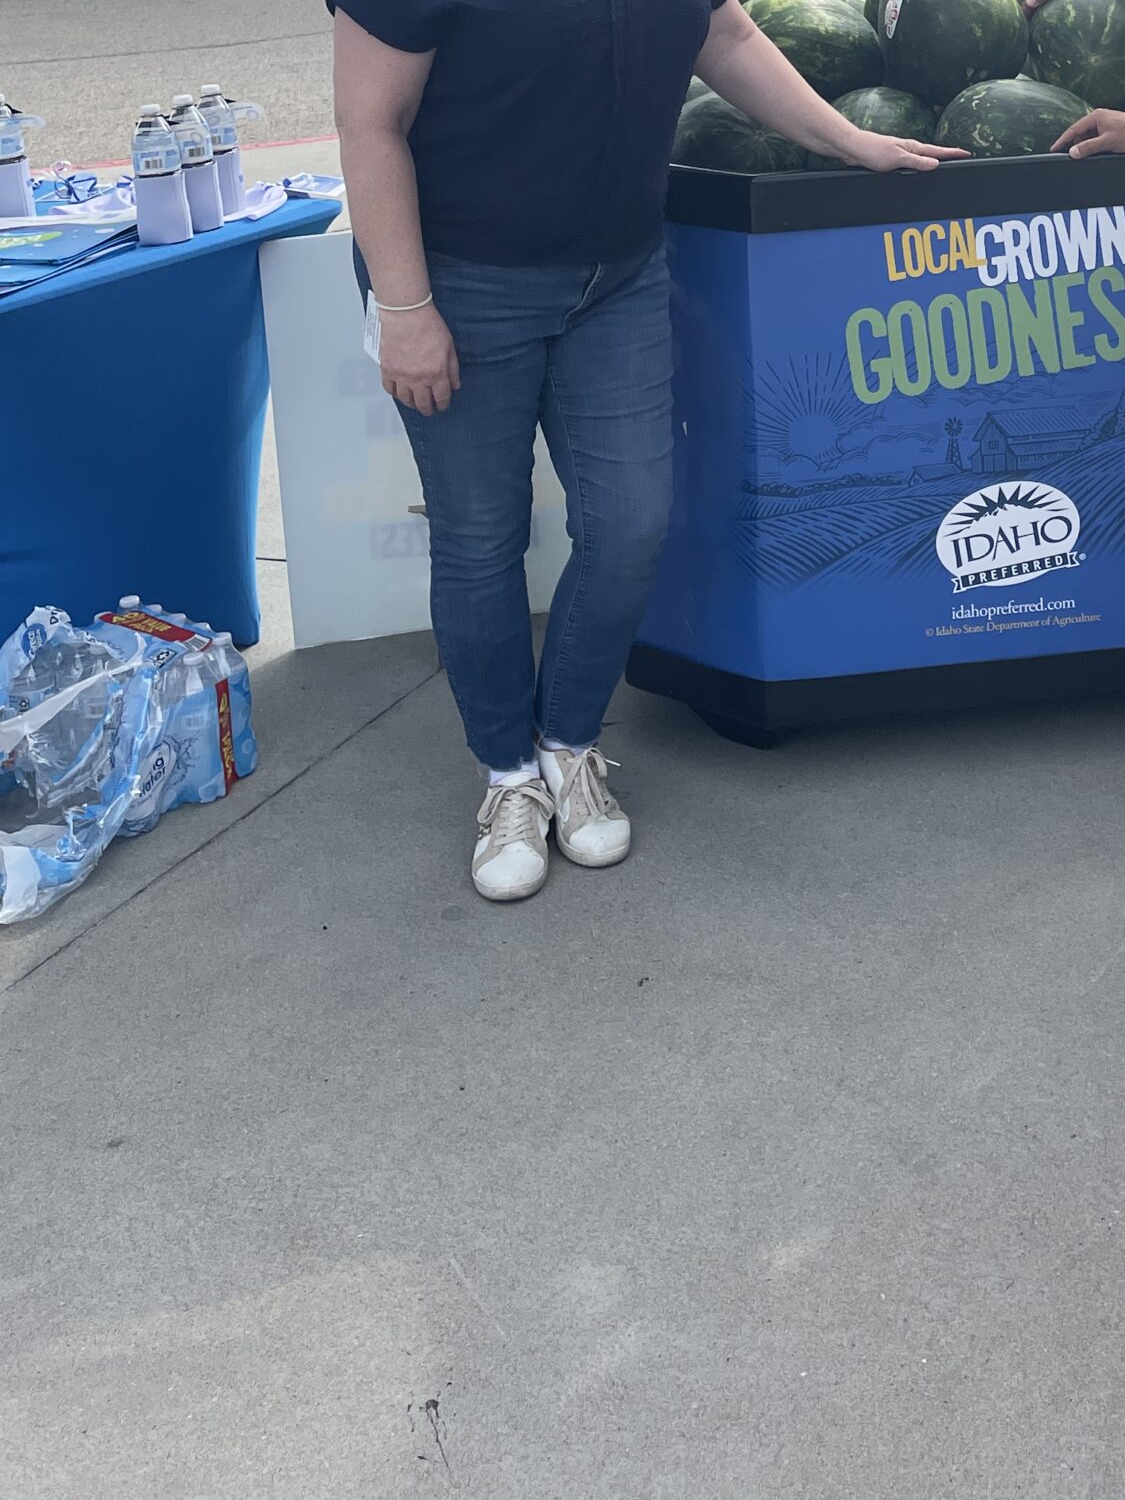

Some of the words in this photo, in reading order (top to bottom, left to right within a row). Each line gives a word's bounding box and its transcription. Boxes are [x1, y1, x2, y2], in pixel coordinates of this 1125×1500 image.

[950, 515, 1073, 569] IDAHO
[968, 555, 1063, 586] PREFERRED
[951, 597, 1076, 621] idahopreferred.com
[936, 623, 962, 637] Idaho
[963, 621, 984, 634] State
[986, 617, 1040, 633] Department
[1041, 615, 1052, 626] of
[1052, 612, 1102, 629] Agriculture
